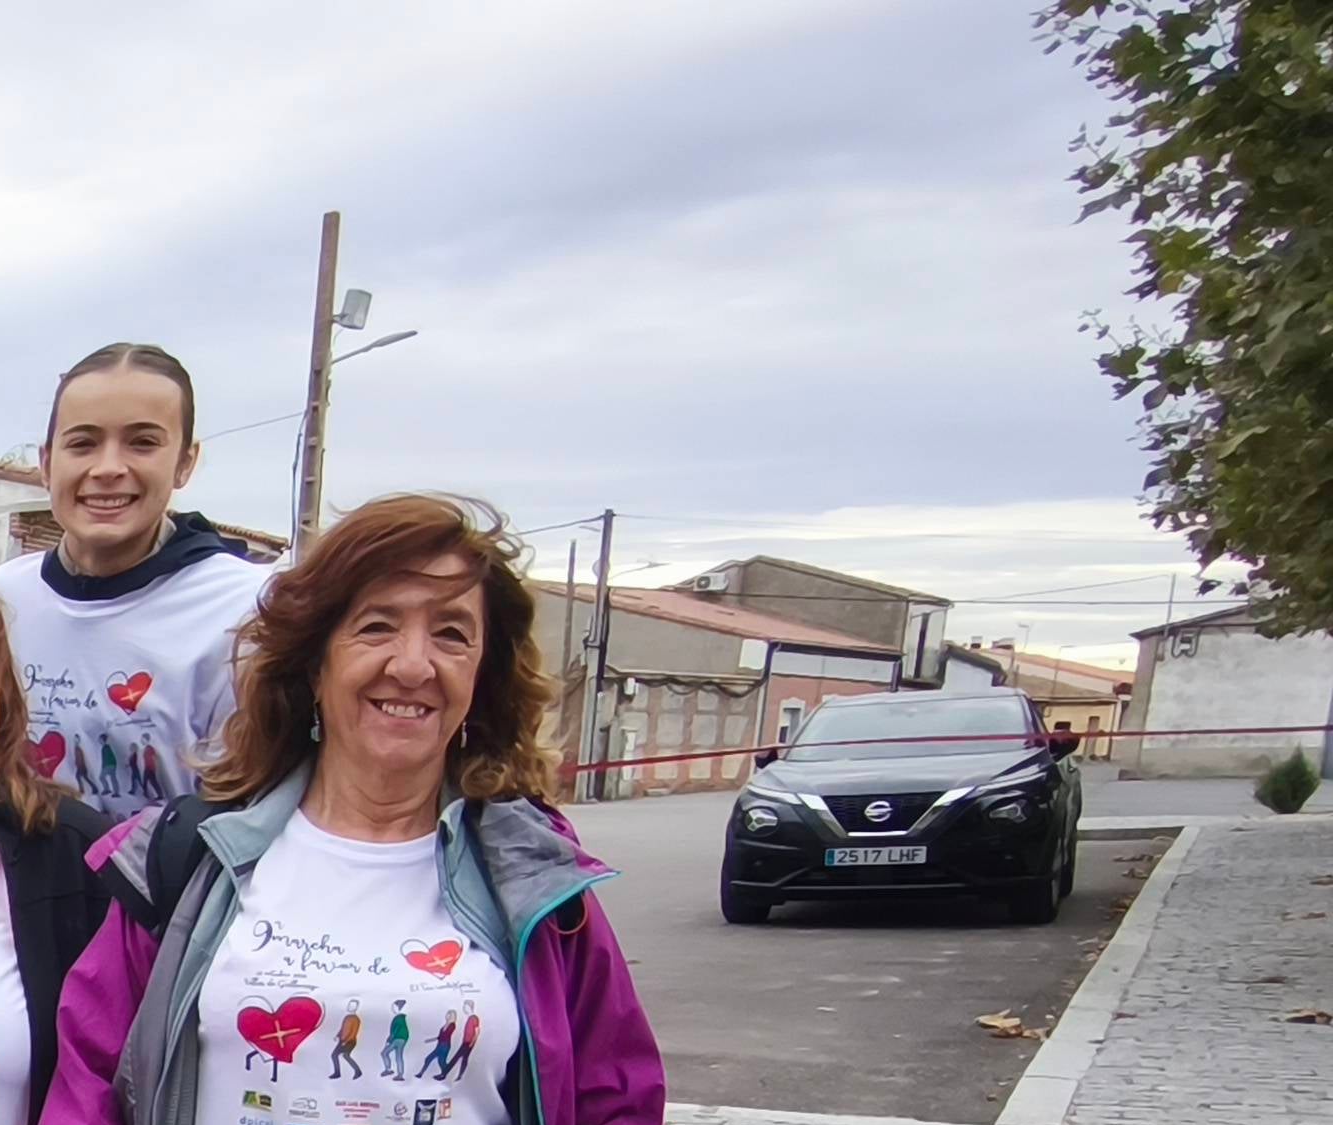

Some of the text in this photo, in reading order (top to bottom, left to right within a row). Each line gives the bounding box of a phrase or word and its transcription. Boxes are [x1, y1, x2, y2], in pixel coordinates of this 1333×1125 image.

[837, 850, 883, 863] 2517
[272, 934, 345, 955] marcha
[301, 952, 362, 974] favor
[368, 957, 391, 976] de
